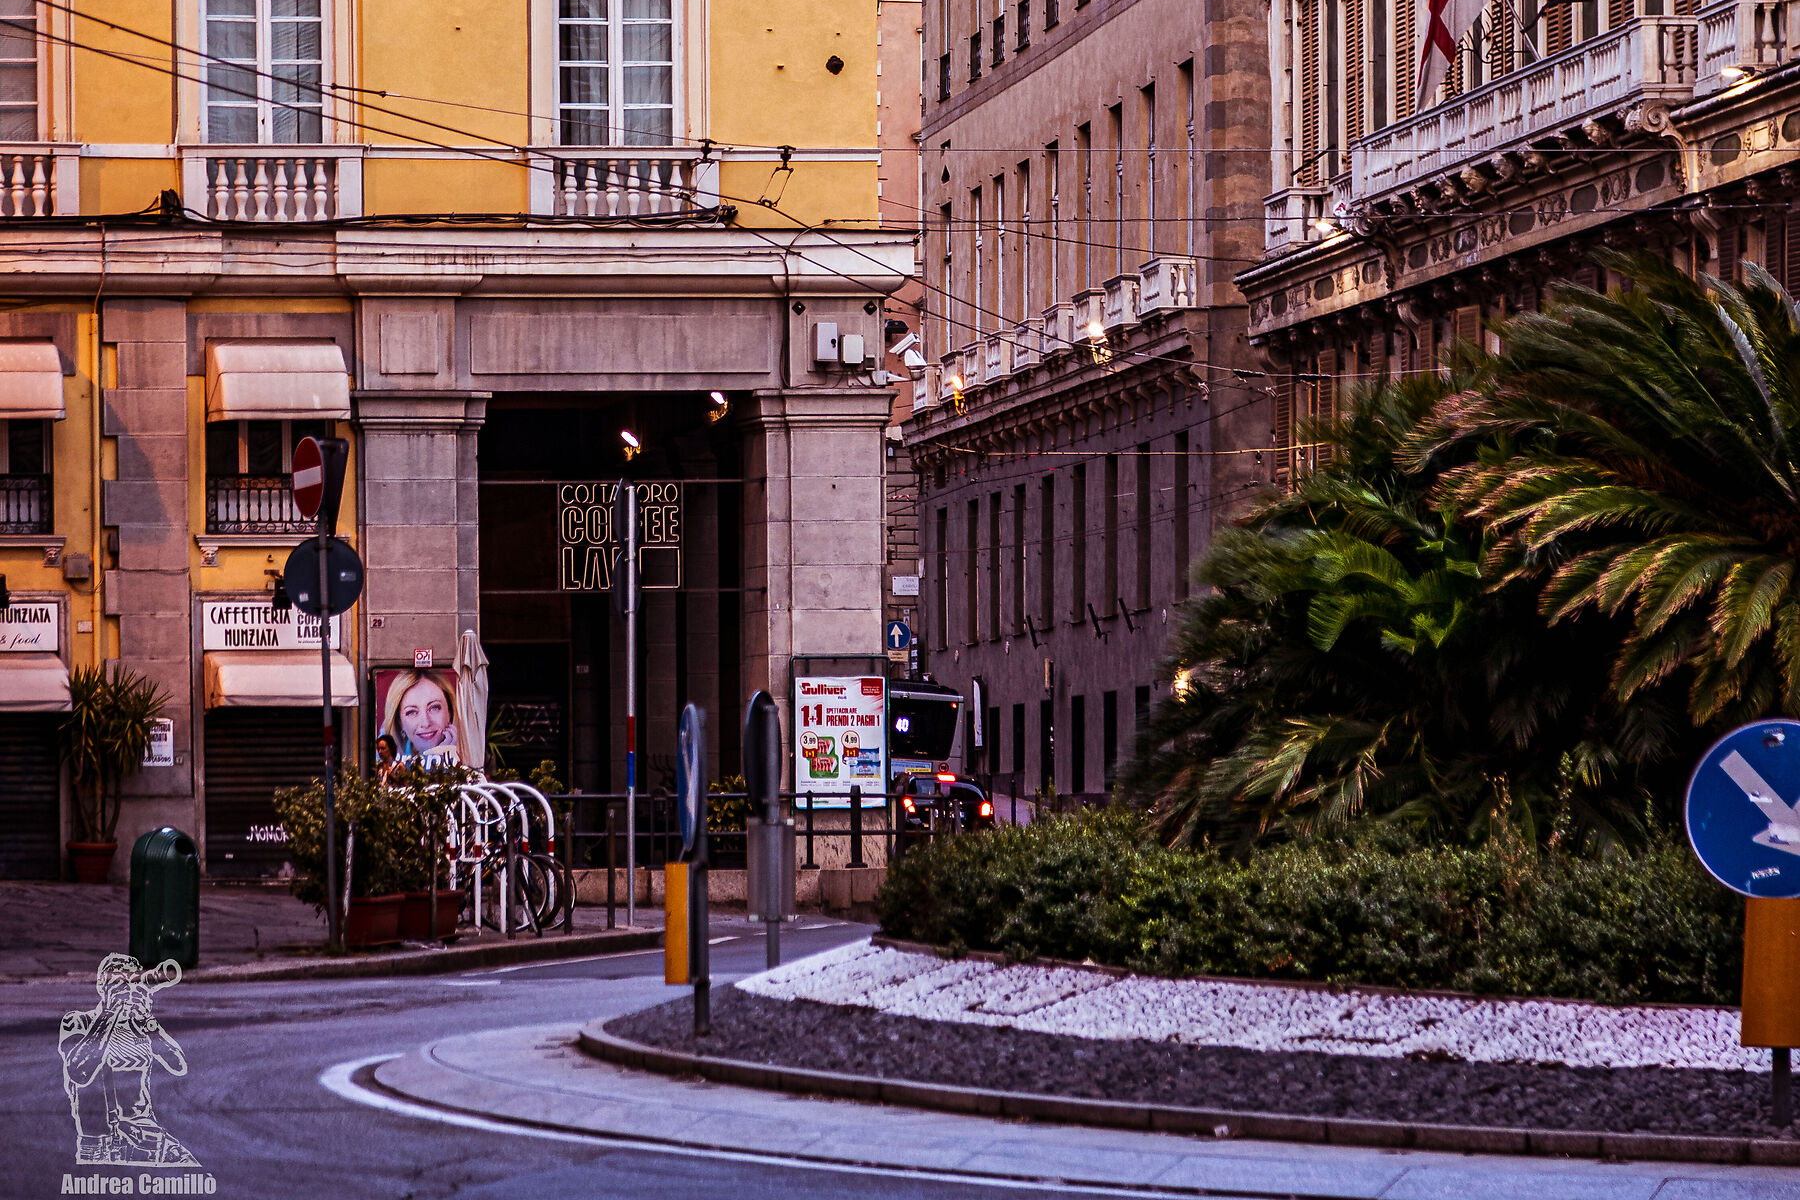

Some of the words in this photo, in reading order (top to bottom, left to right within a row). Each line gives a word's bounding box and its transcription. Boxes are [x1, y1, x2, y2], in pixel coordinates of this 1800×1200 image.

[562, 546, 621, 590] LA
[210, 606, 291, 624] CAFFETTERIA
[372, 618, 383, 628] 29
[9, 633, 41, 649] food
[224, 628, 279, 647] NUNZIATA
[800, 682, 847, 696] Gulliver
[800, 703, 823, 728] 1+1
[826, 714, 849, 727] PRENDI
[850, 714, 856, 727] 2
[856, 714, 876, 727] PAGHI
[876, 714, 880, 726] 1
[895, 716, 910, 733] 40
[803, 735, 817, 745] 3,99
[844, 734, 858, 744] 4,99
